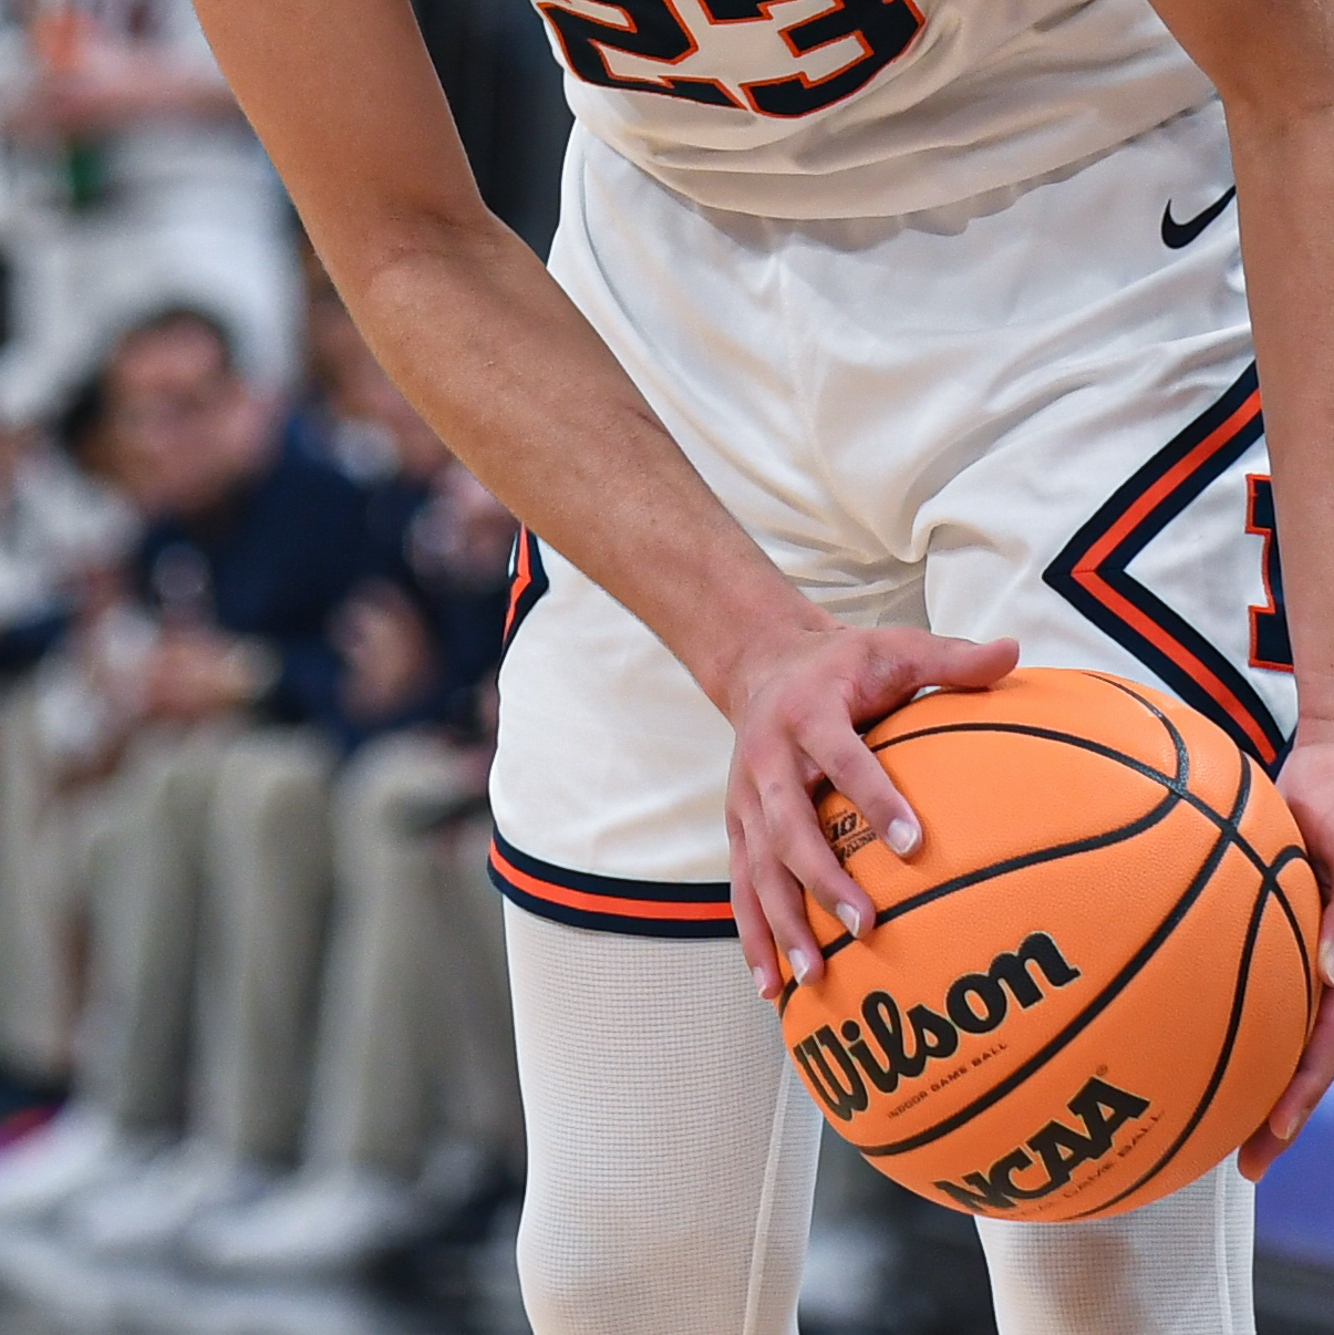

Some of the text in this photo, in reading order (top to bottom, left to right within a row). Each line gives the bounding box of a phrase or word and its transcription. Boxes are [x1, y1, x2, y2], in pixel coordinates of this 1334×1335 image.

[792, 930, 1082, 1123] Wilson
[930, 1066, 968, 1093] GAME
[971, 1043, 1007, 1067] BALL
[931, 1074, 1152, 1214] NCAA
